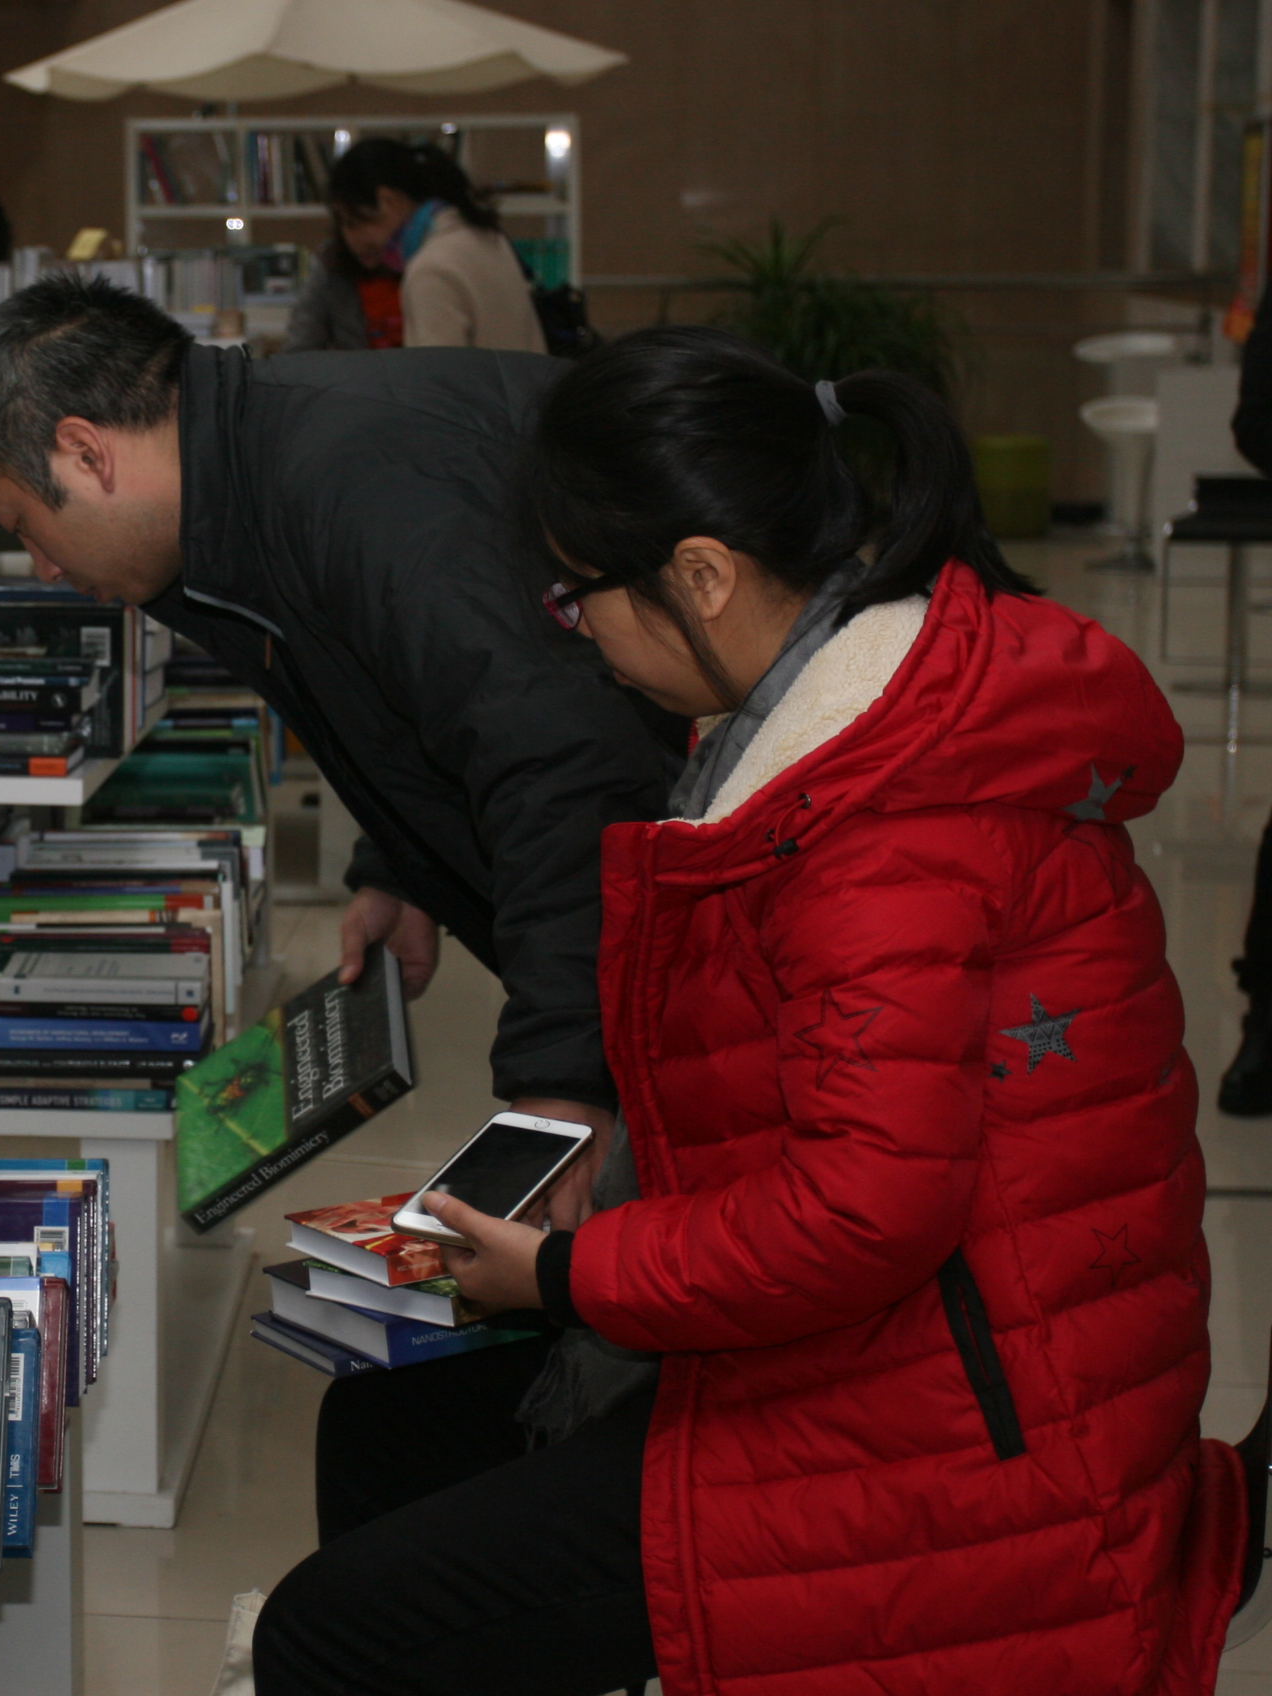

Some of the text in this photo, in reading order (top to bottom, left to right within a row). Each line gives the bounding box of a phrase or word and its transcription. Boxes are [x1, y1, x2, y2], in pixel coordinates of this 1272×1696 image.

[287, 1009, 320, 1122] Engineered
[193, 1172, 263, 1224] Engineered
[7, 1493, 19, 1536] WILEY
